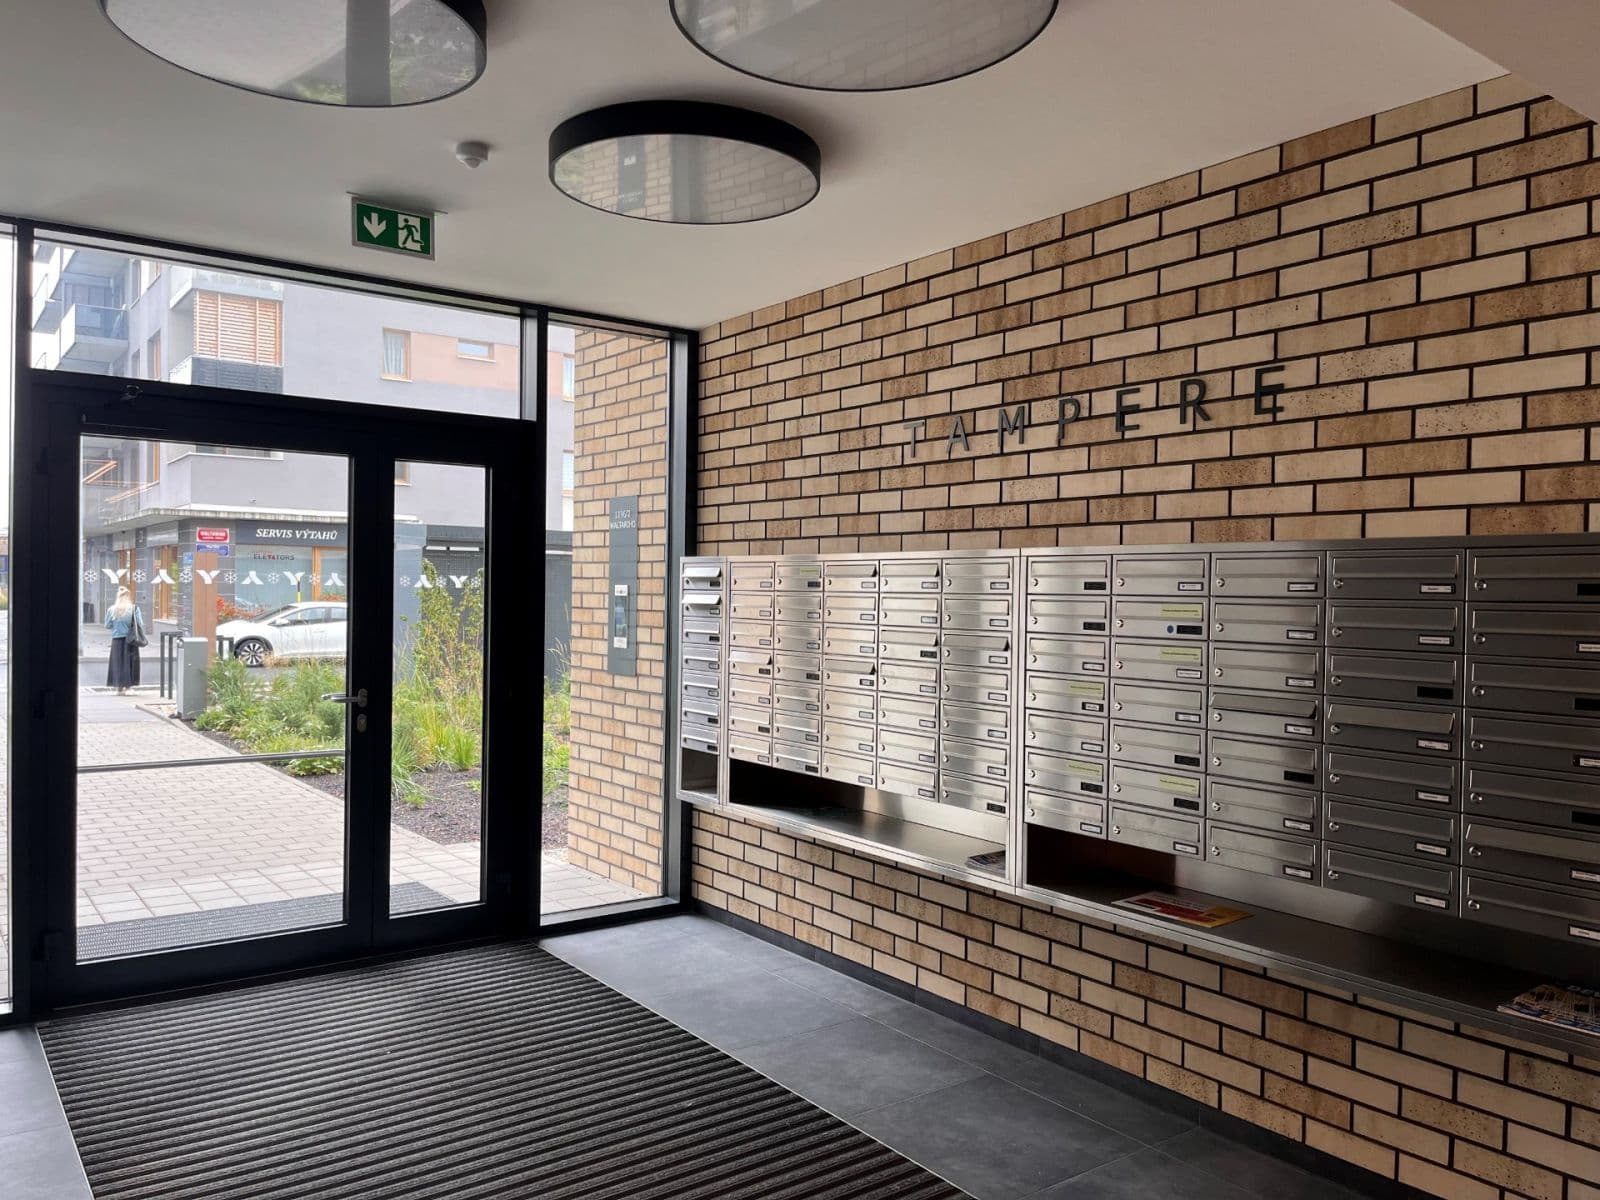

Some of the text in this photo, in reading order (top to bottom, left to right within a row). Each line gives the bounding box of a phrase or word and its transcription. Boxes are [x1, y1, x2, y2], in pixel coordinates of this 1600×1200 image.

[902, 364, 1286, 459] TAMPERE
[256, 528, 338, 541] SERVIS VÝTAHŮ
